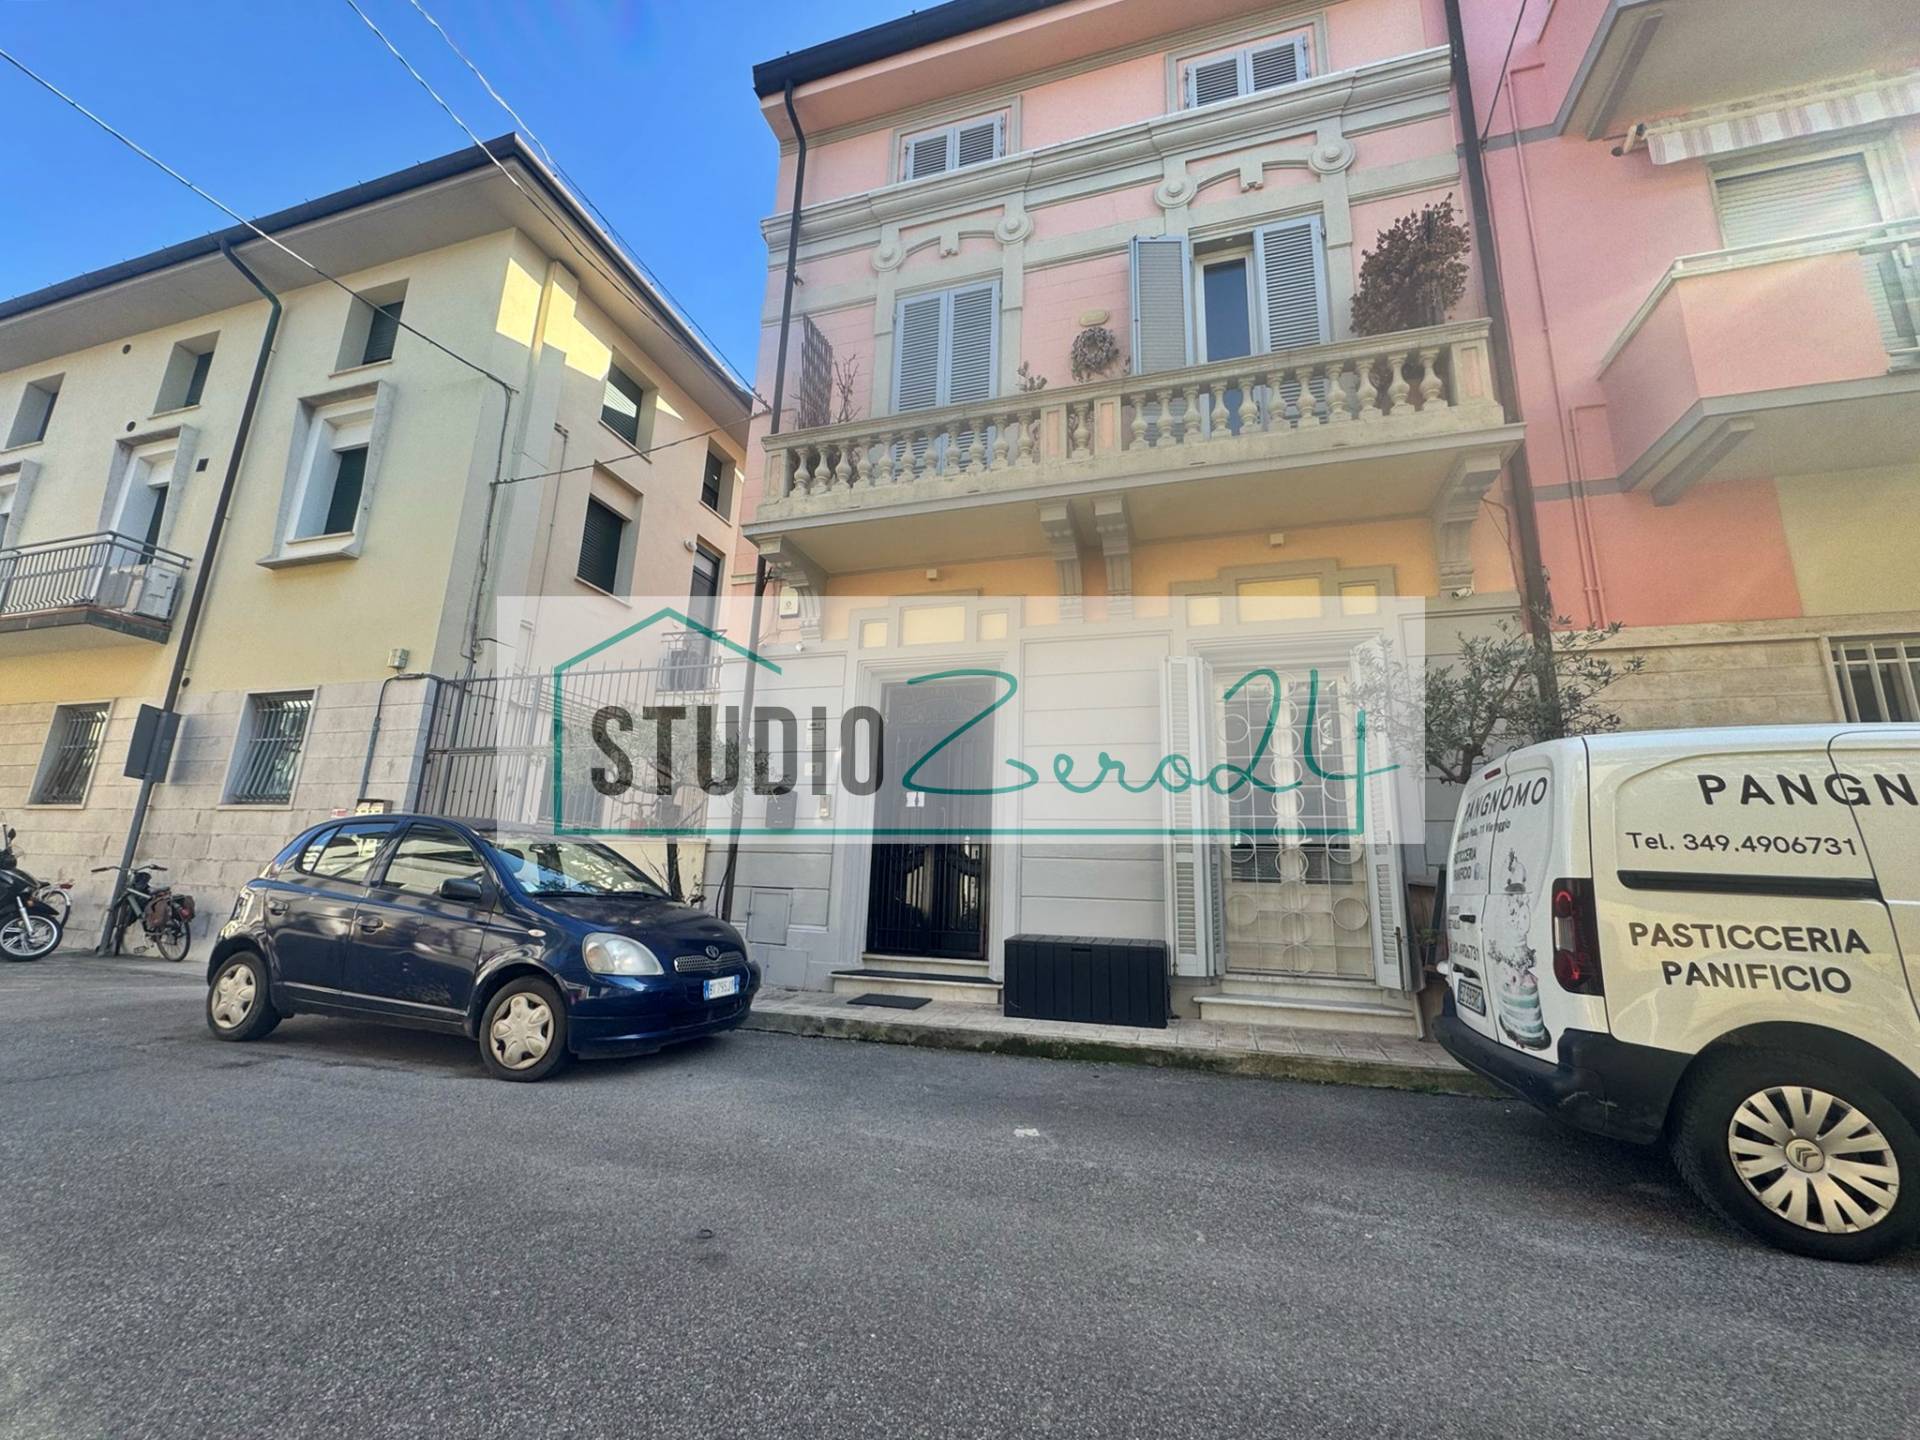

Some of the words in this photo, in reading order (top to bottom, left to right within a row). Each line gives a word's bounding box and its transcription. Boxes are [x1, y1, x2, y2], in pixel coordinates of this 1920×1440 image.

[1697, 773, 1919, 806] PANGN
[1625, 832, 1674, 850] Tel.
[1682, 833, 1857, 856] 349.4906731
[1629, 922, 1872, 954] PASTICCERIA
[1661, 960, 1852, 994] PANIFICIO
